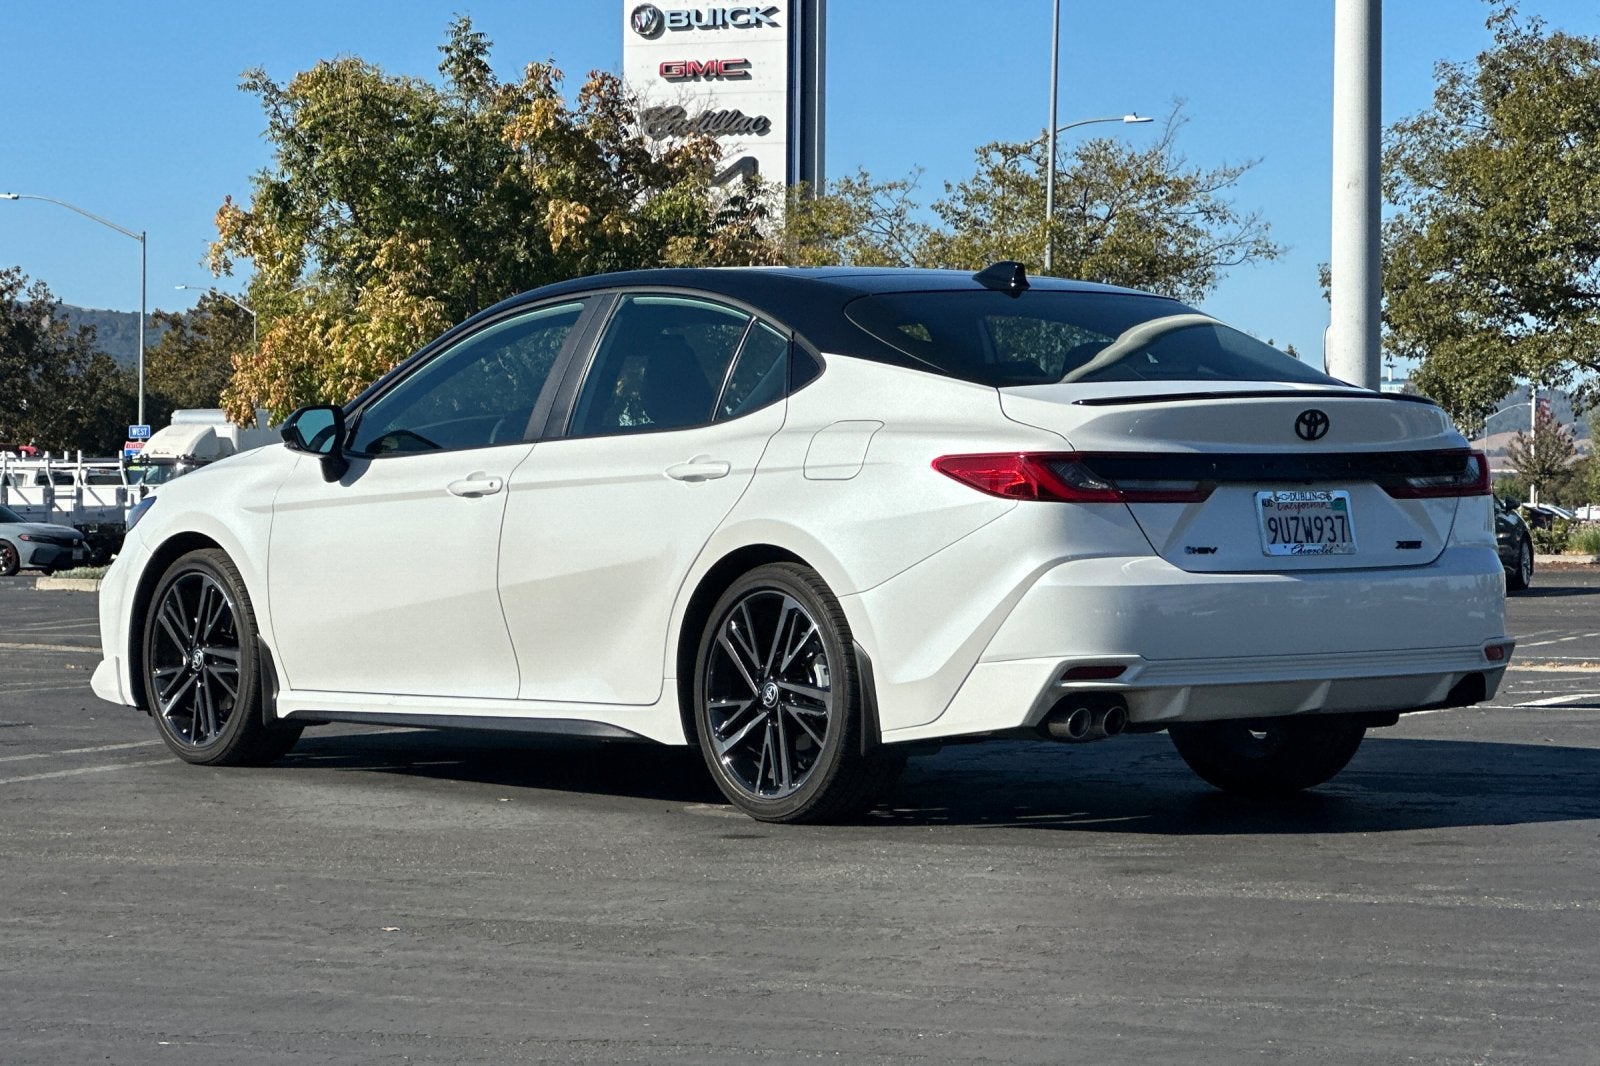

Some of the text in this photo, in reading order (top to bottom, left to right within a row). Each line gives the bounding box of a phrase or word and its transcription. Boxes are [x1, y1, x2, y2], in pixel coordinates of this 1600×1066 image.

[665, 6, 781, 28] BUICK
[659, 59, 749, 79] GMC
[131, 428, 147, 436] WEST
[1289, 491, 1318, 501] DUBLIN
[1277, 502, 1328, 514] California
[1267, 515, 1346, 544] 9UZW937
